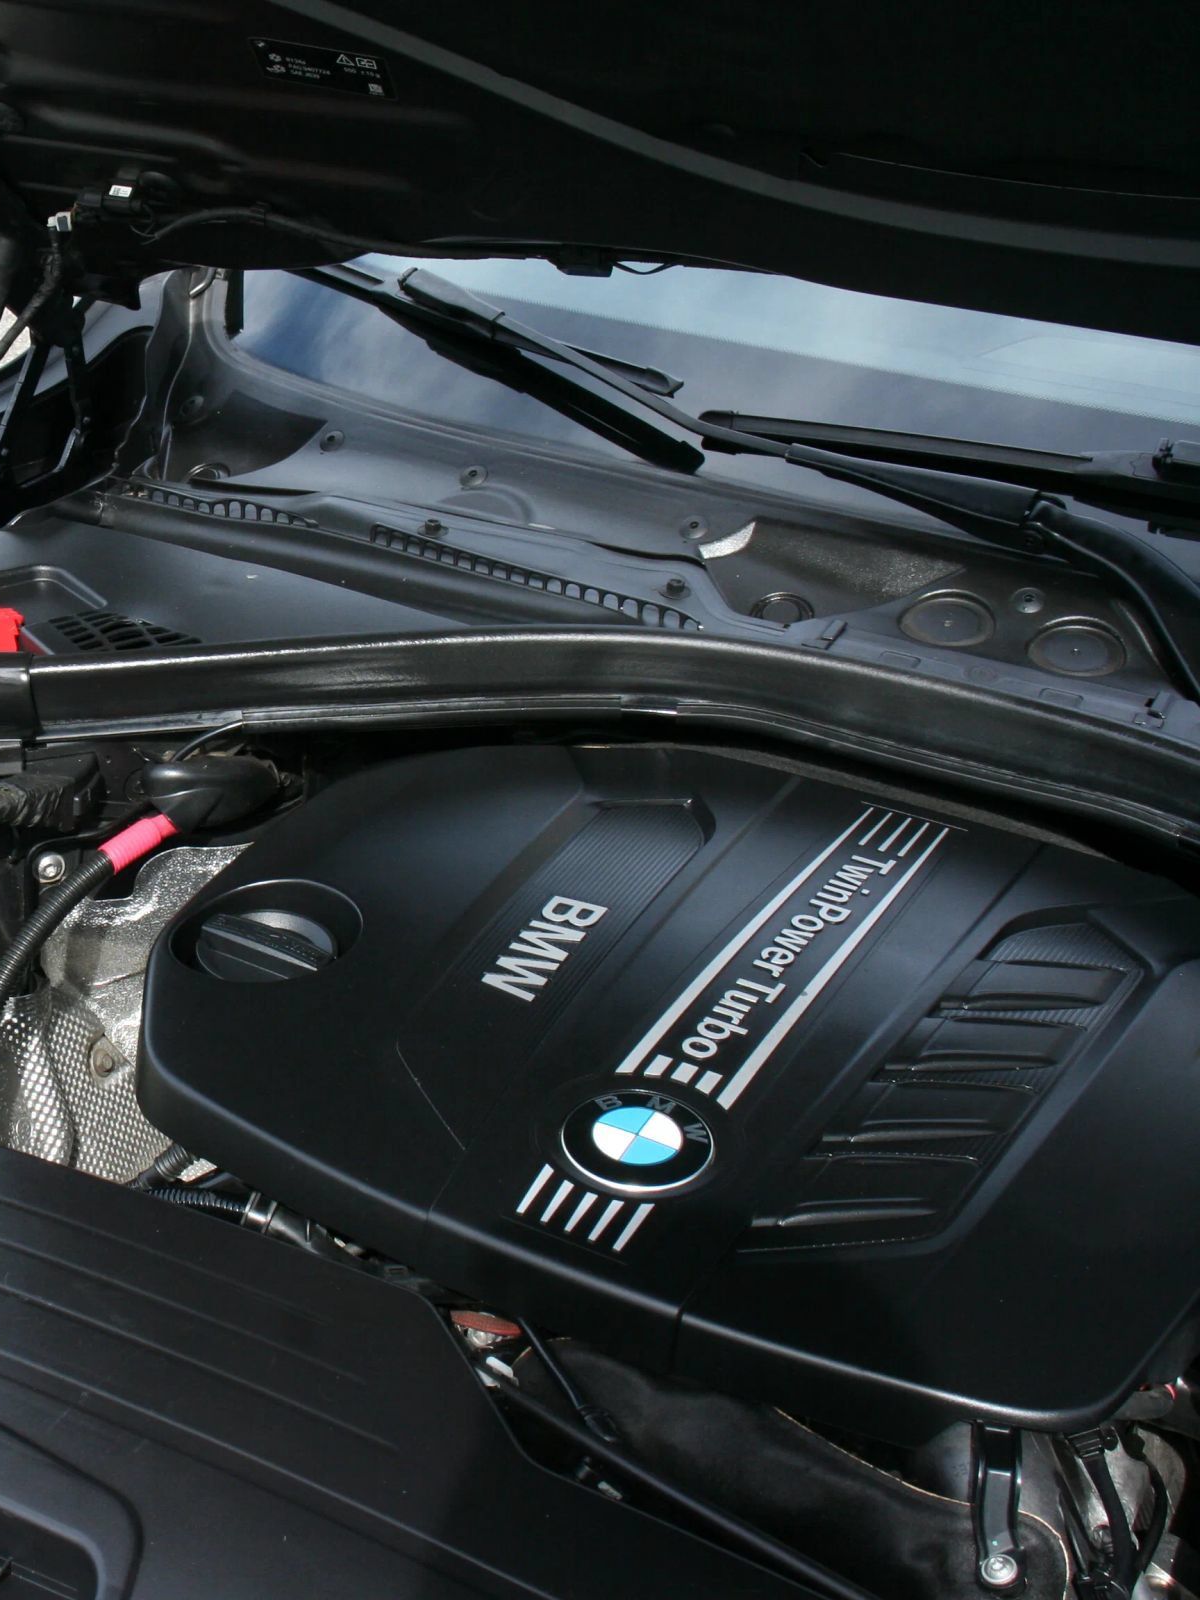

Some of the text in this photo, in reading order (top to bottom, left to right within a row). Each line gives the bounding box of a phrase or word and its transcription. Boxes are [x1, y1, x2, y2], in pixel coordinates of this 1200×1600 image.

[481, 895, 608, 1002] BMW
[681, 854, 896, 1059] TwinPower Turbo
[595, 1096, 708, 1144] BMW
